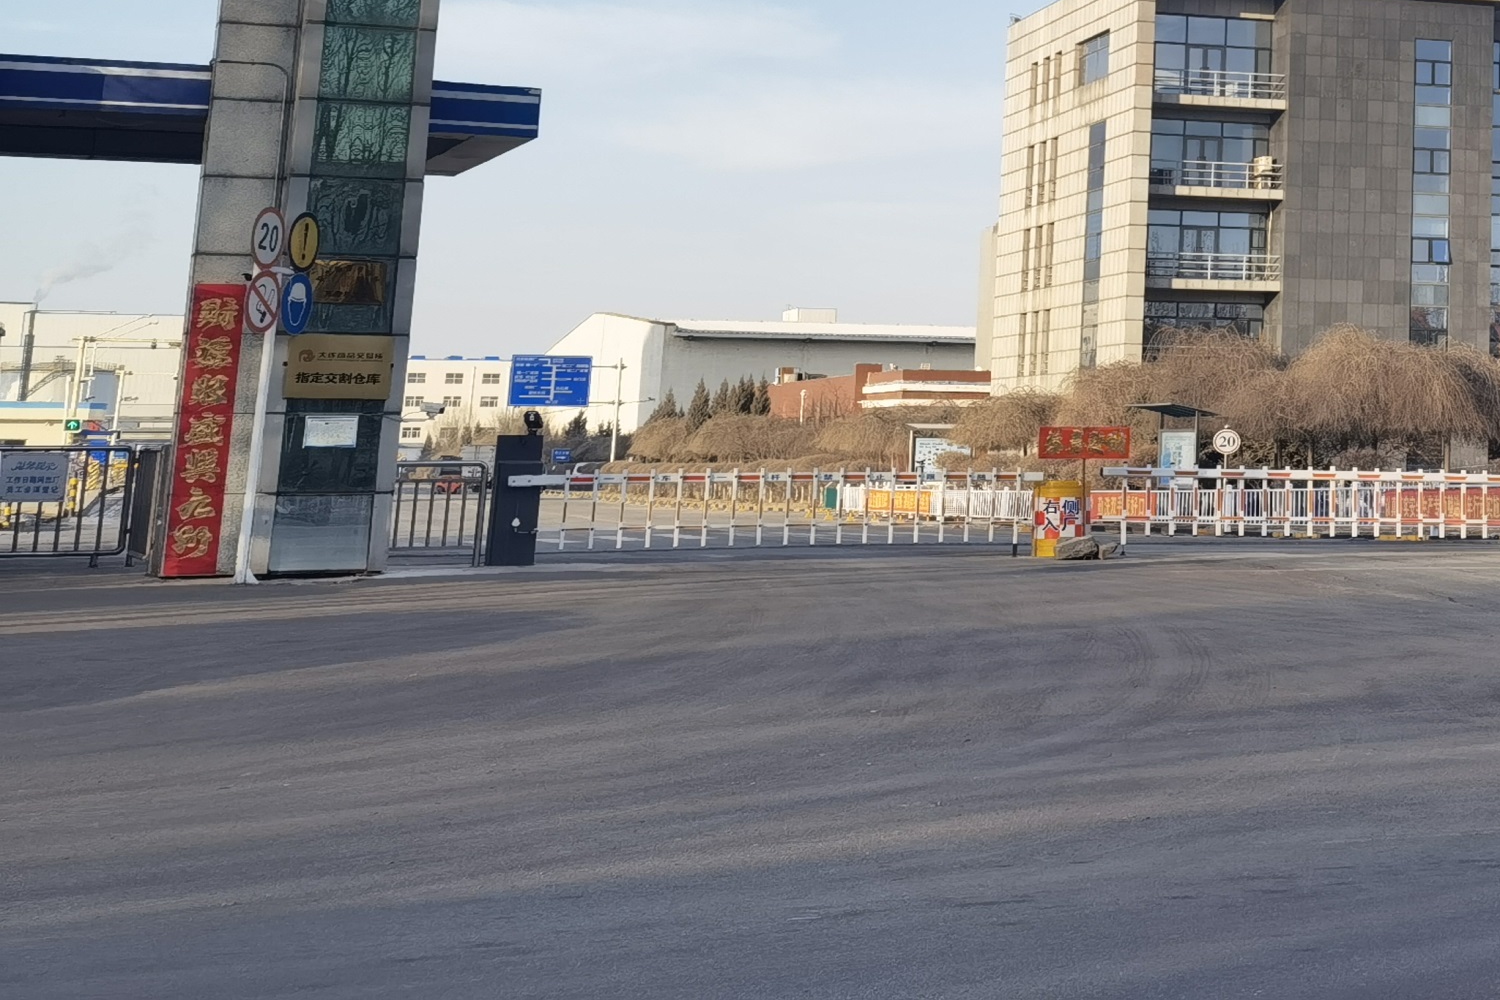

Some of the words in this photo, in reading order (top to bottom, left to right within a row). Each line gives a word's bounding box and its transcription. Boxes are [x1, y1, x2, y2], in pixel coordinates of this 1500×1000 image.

[258, 222, 279, 252] 20
[295, 371, 382, 385] 指定交割仓库
[1219, 435, 1236, 448] 20
[1043, 499, 1080, 515] 右侧
[1042, 516, 1080, 532] 入厂
